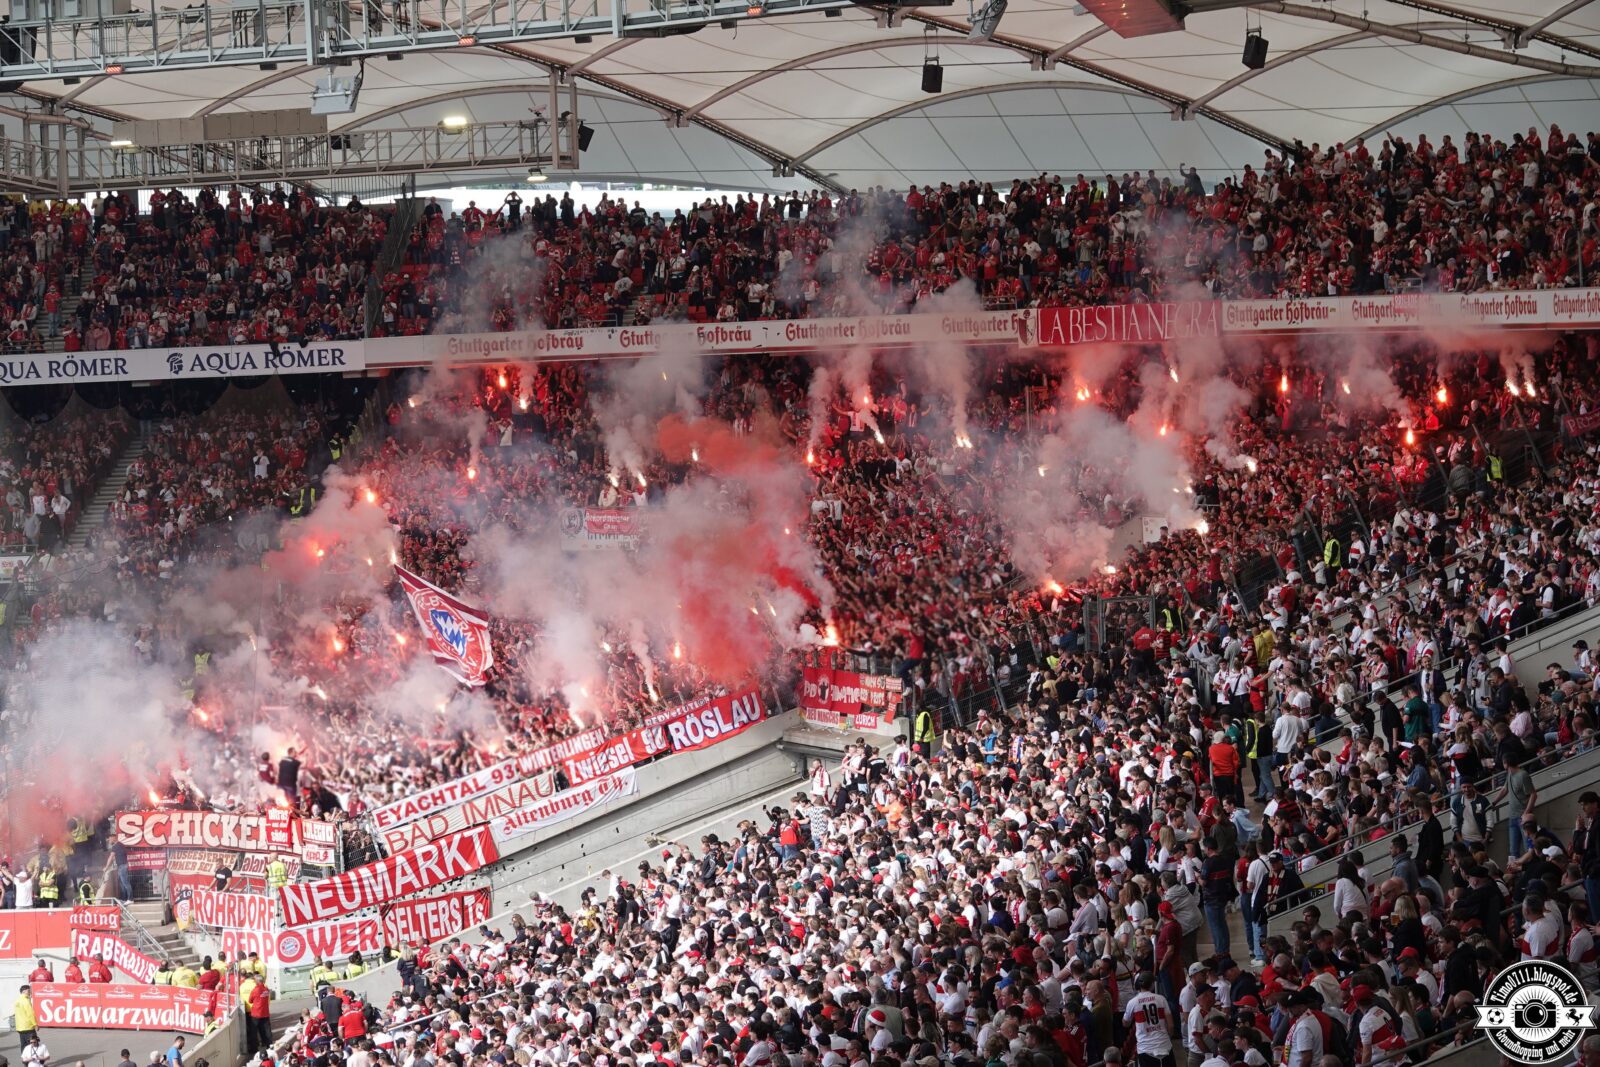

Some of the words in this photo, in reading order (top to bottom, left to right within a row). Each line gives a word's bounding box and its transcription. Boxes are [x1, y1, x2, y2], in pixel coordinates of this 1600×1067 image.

[1038, 308, 1064, 344] LA
[1070, 304, 1143, 343] BESTIA
[1147, 301, 1219, 340] NEGRA
[1227, 302, 1283, 326] Stuttgarter
[1285, 301, 1329, 324] Hofbräu
[1460, 296, 1502, 319] Stuttgarter
[1504, 295, 1537, 319] Hofbräu
[1553, 293, 1586, 318] Stuttgarter
[696, 326, 752, 345] Hofbräu
[785, 322, 855, 341] Stuttgarter
[942, 314, 1008, 338] Stuttgarter
[190, 351, 258, 374] AQUA
[264, 346, 346, 369] RÖMER
[448, 336, 523, 356] Stuttgarter
[48, 355, 128, 378] RÖMER
[668, 691, 761, 751] RÖSLAU
[518, 728, 606, 772] WINTERLINGEN
[565, 737, 635, 785] Zwiesel
[376, 777, 487, 827] EYACHTAL
[491, 764, 516, 784] 93
[503, 789, 593, 835] Altenburg
[384, 813, 450, 854] BAD
[462, 773, 555, 825] IMNAU
[284, 827, 487, 925] NEUMARKT
[194, 891, 275, 931] ROHRDORF
[384, 896, 463, 947] SELTERS
[1142, 1003, 1159, 1026] 19
